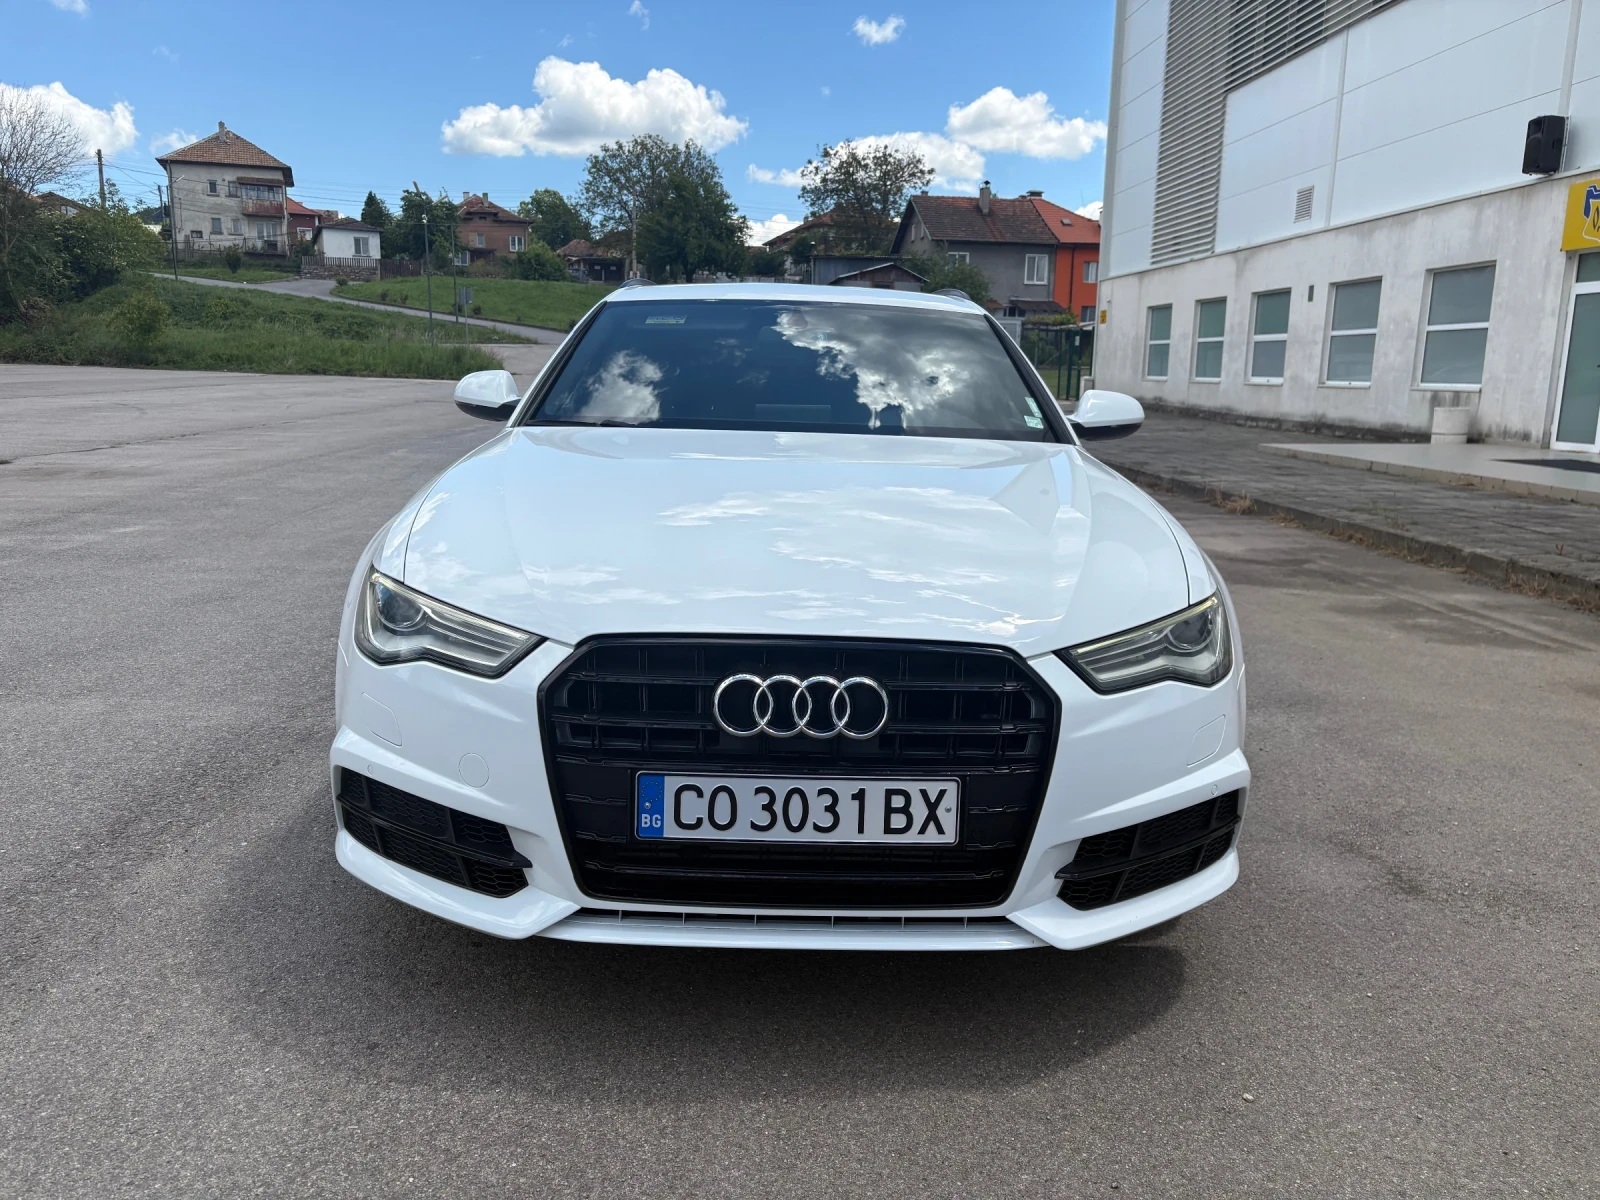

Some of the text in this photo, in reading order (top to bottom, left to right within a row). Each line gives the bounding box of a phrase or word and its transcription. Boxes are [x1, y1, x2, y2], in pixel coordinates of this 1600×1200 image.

[641, 814, 661, 828] BG
[750, 786, 866, 834] 3031
[883, 788, 947, 835] BX
